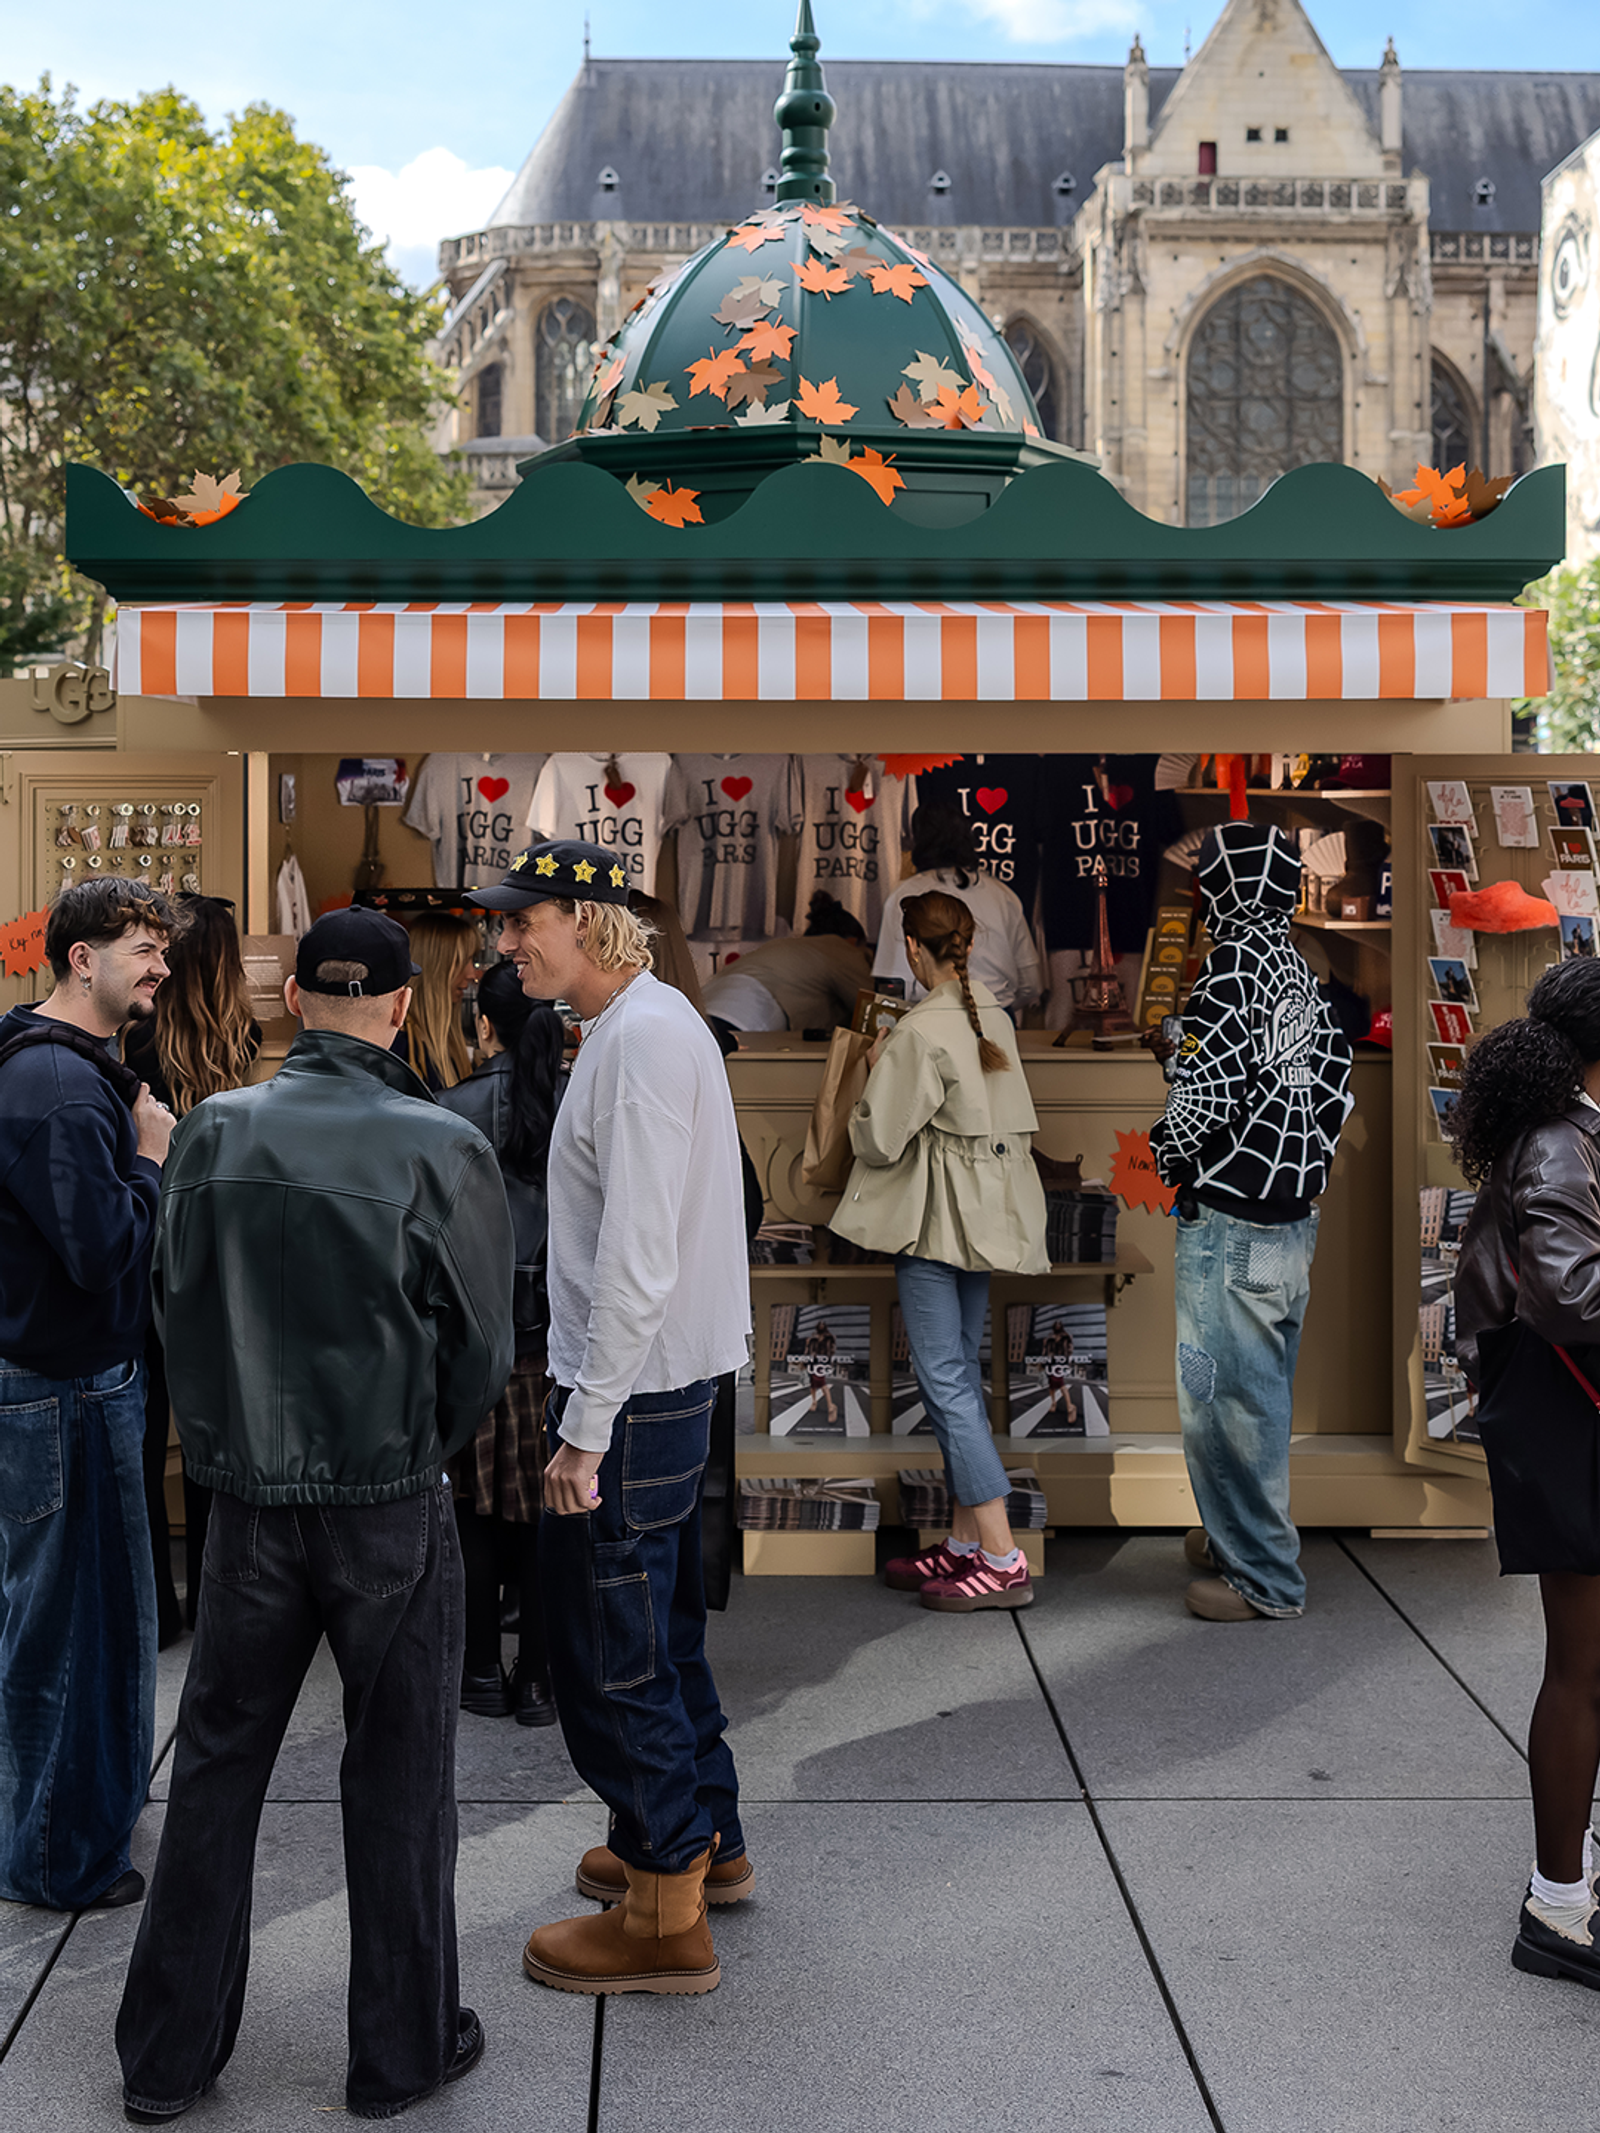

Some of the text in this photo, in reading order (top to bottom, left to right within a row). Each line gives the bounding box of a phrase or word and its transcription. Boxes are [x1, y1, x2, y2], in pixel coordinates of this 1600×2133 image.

[585, 784, 601, 813] I
[702, 779, 718, 806] I
[825, 786, 840, 815] I
[957, 788, 972, 816] I
[1081, 784, 1099, 813] I
[575, 816, 644, 847] UGG
[694, 810, 760, 841] UGG
[812, 821, 880, 854] UGG
[971, 822, 1017, 854] GG
[1071, 819, 1141, 850] UGG
[463, 846, 511, 870] ARIS
[1075, 854, 1140, 878] PARIS
